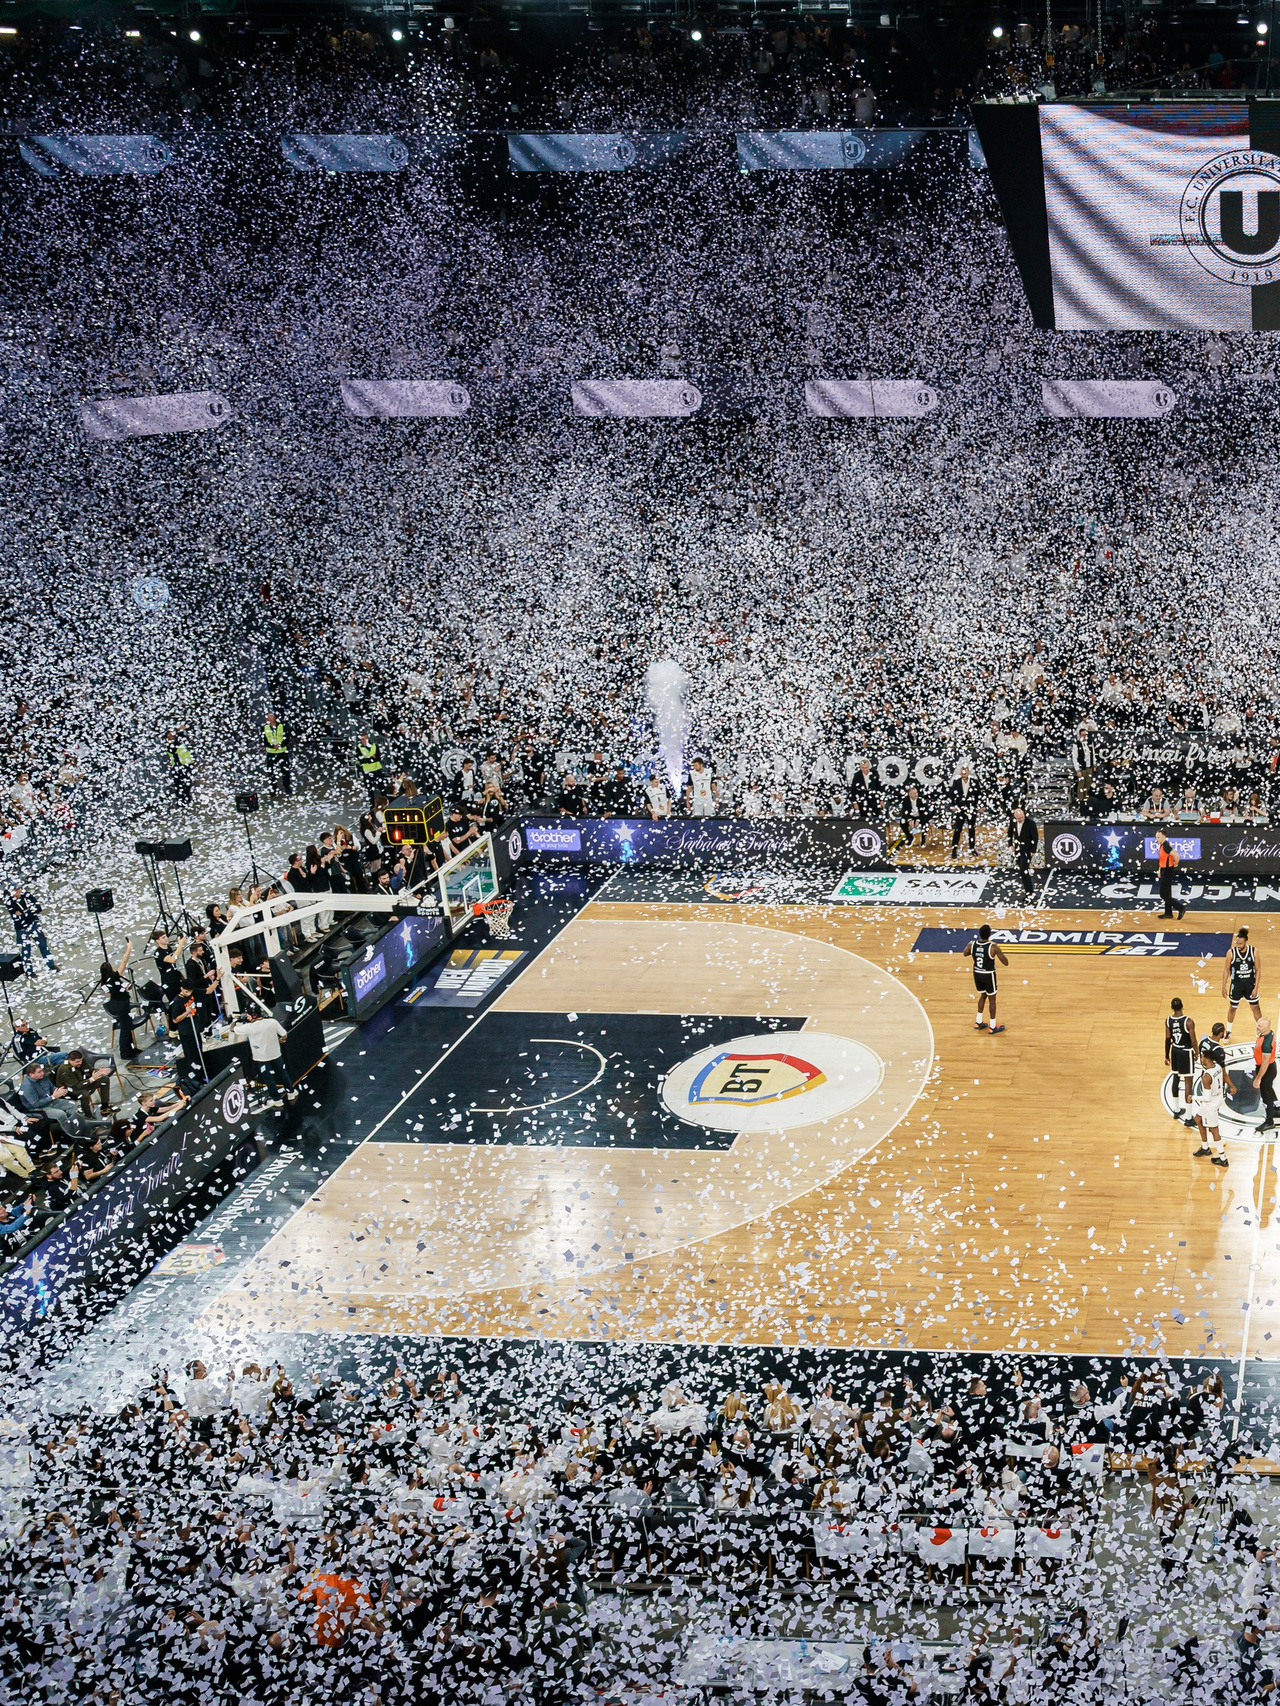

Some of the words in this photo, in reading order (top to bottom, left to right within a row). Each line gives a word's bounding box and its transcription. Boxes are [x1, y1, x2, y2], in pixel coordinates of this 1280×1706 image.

[1184, 197, 1198, 222] F.C.
[1220, 191, 1280, 256] U
[1230, 269, 1274, 282] 1919
[530, 832, 575, 845] brother
[988, 930, 1179, 946] ADMIRAL
[1106, 946, 1178, 955] BET
[976, 957, 984, 968] 2
[719, 1063, 771, 1094] BT
